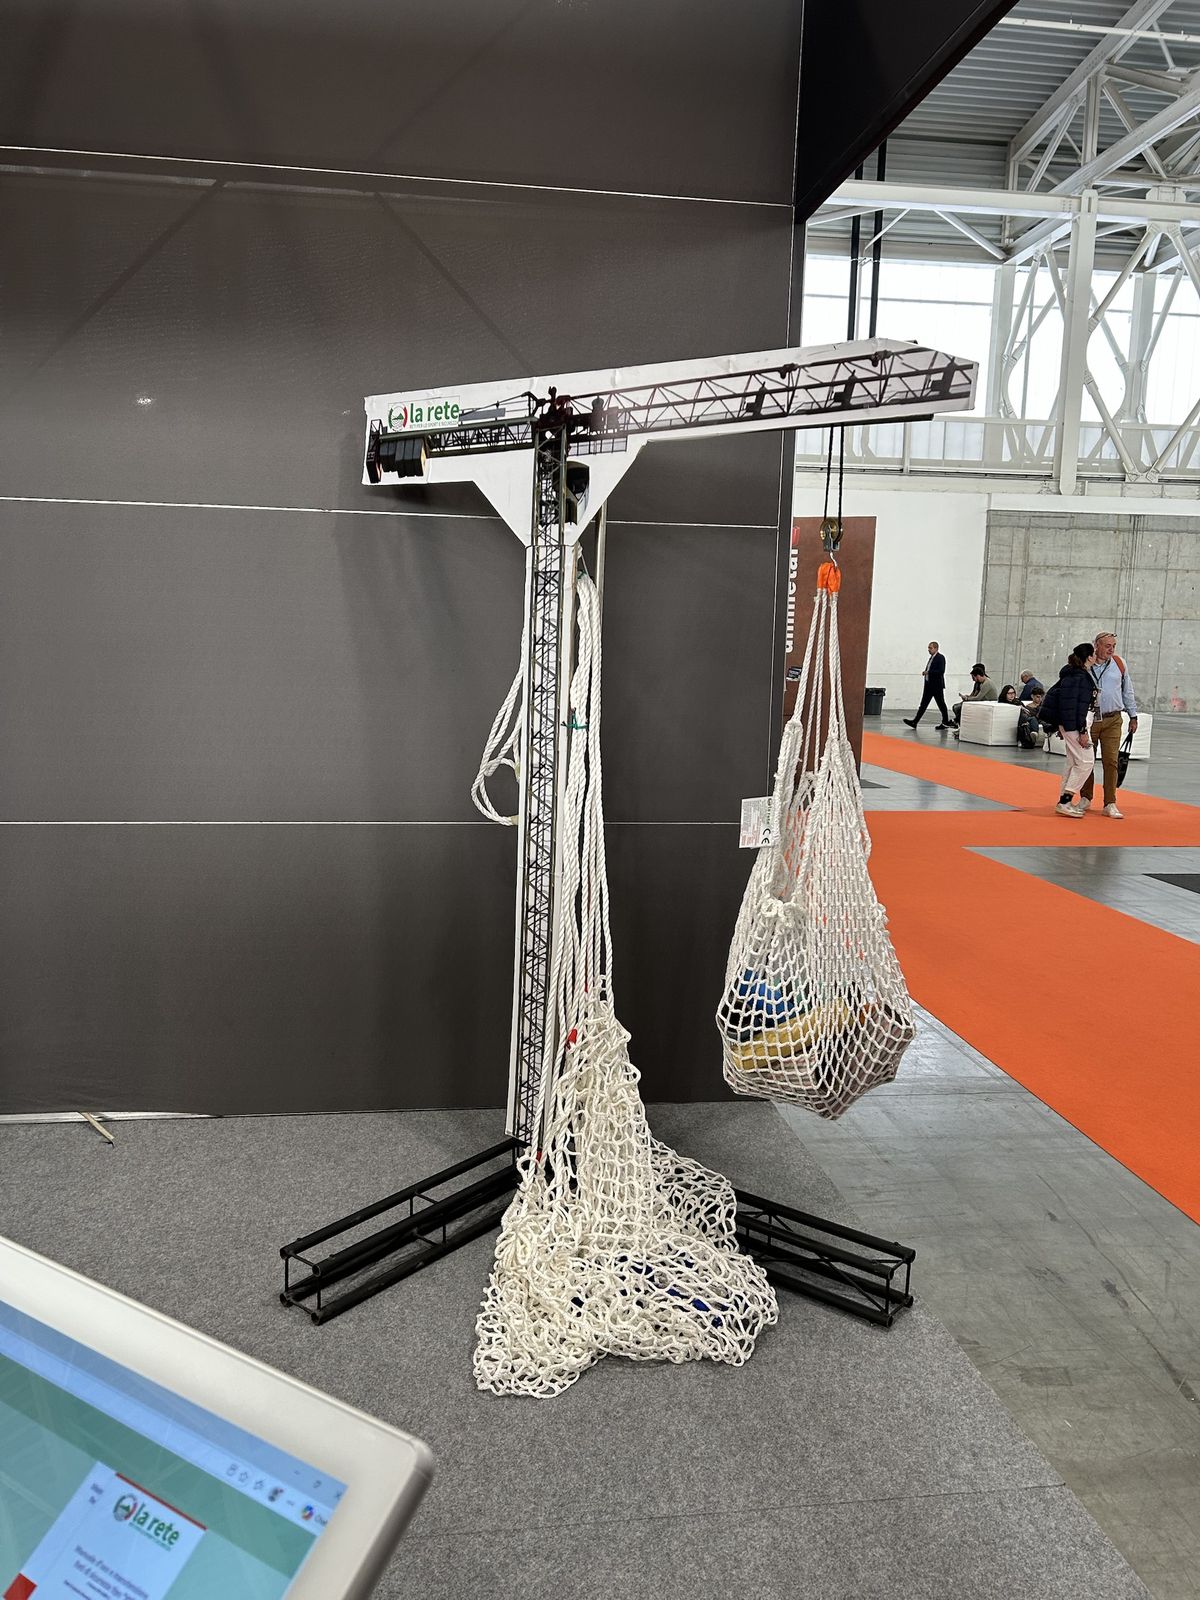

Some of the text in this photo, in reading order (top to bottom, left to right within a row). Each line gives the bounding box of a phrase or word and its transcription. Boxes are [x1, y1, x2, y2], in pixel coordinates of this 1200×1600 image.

[410, 401, 460, 423] la rete
[761, 828, 771, 844] CE
[132, 1502, 150, 1526] la
[147, 1517, 180, 1545] rete
